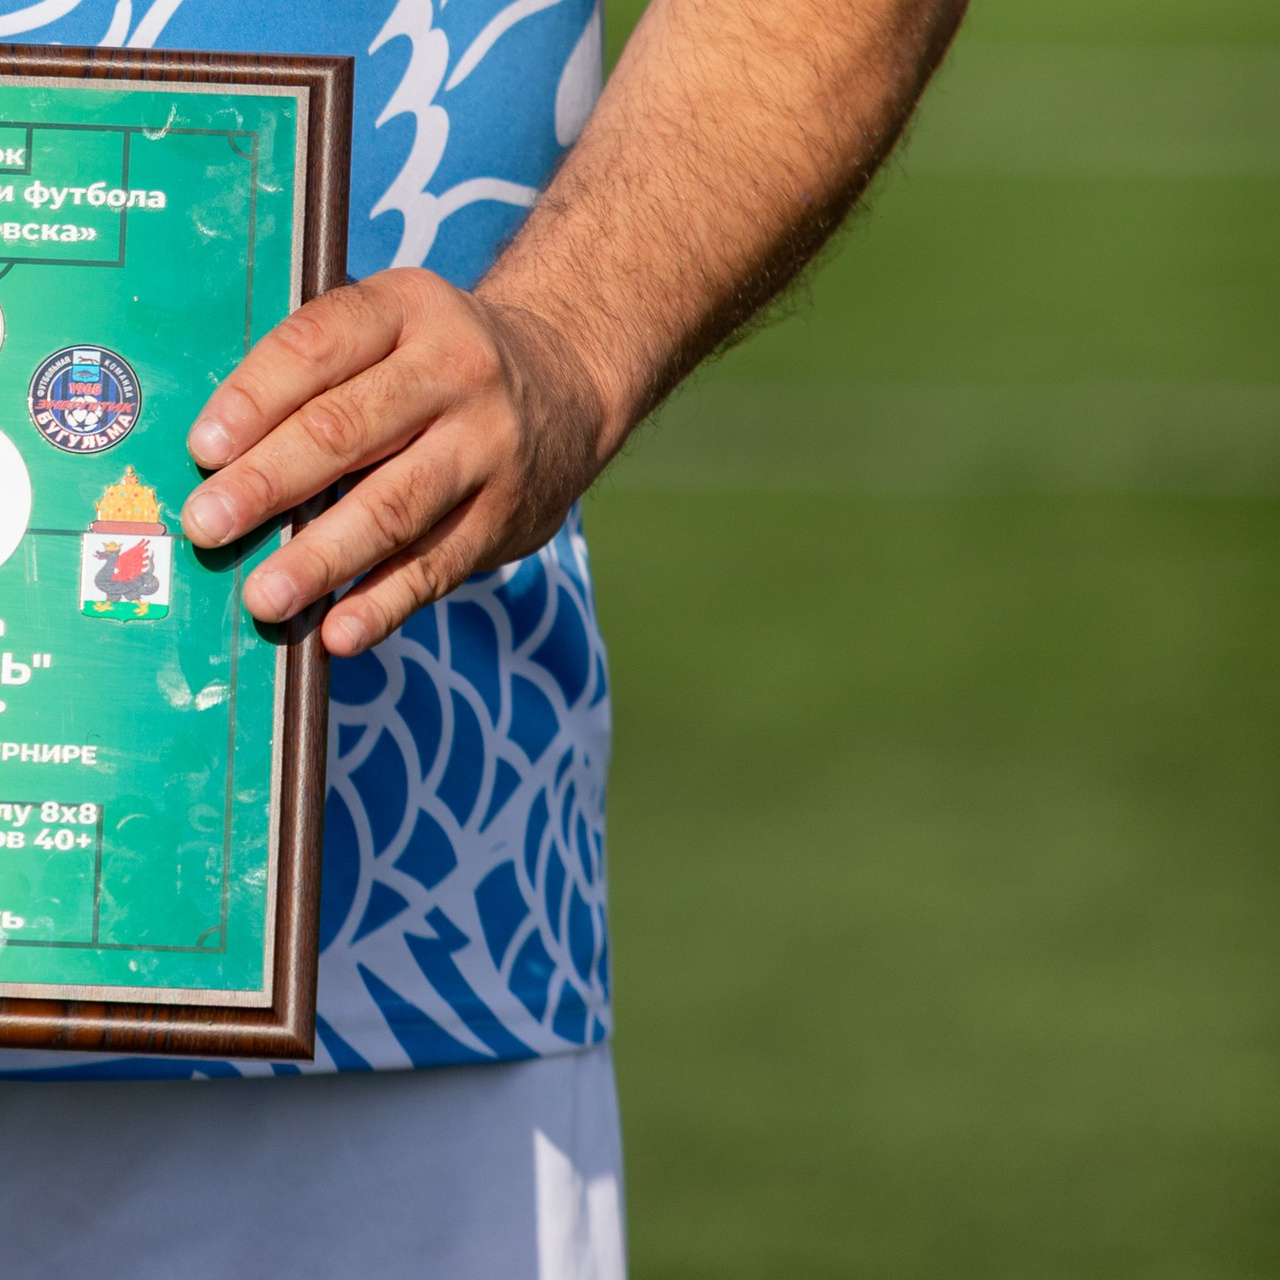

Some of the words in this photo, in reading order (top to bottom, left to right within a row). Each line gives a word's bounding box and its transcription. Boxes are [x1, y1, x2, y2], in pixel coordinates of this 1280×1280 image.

[23, 179, 167, 209] футбола
[36, 355, 72, 397] ФУТБОЛЬНАЯ
[104, 358, 134, 399] КОМАНДА
[35, 398, 136, 413] ЭНЕРГЕТИК
[36, 411, 133, 449] БУГУЛЬМА
[33, 828, 93, 851] 40+
